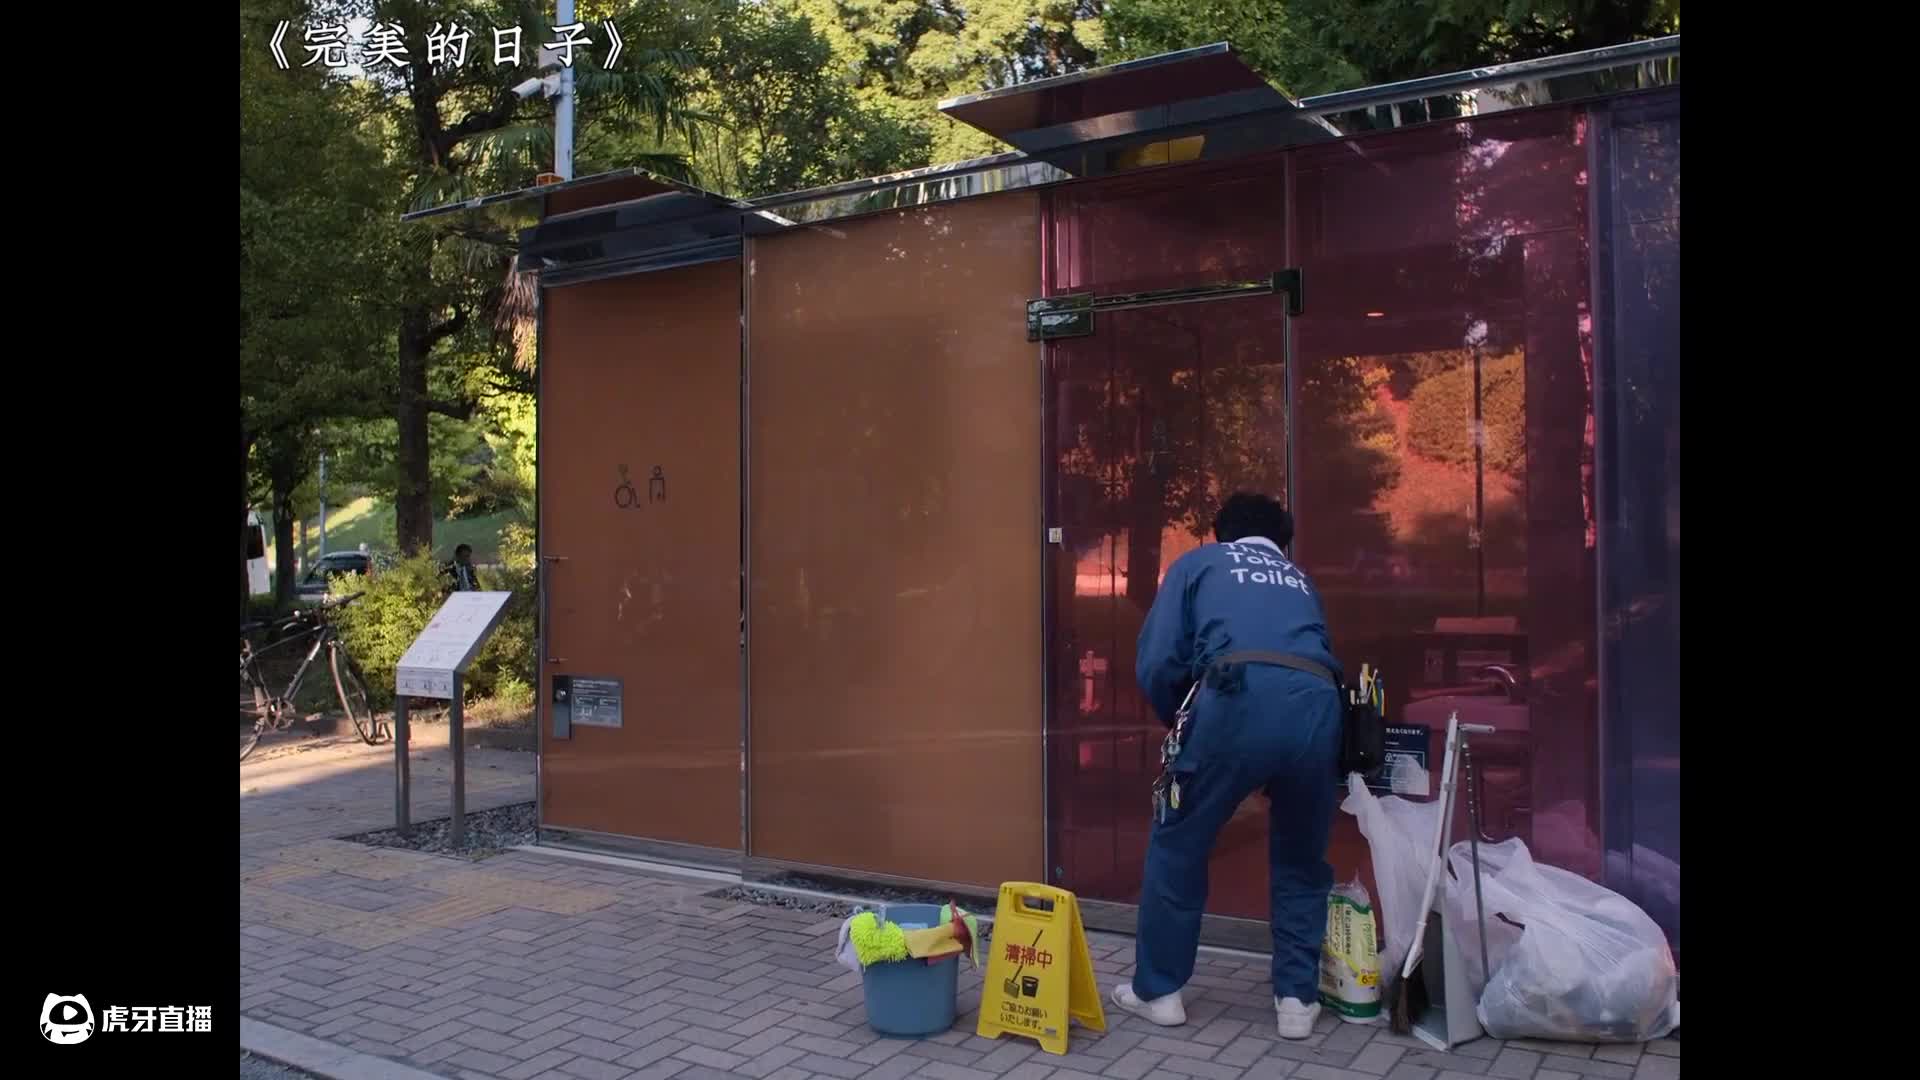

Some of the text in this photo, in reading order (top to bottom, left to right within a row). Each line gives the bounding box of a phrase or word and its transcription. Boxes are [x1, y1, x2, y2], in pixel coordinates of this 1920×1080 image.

[1230, 568, 1310, 595] Toilet
[1004, 943, 1053, 969] 清掃中
